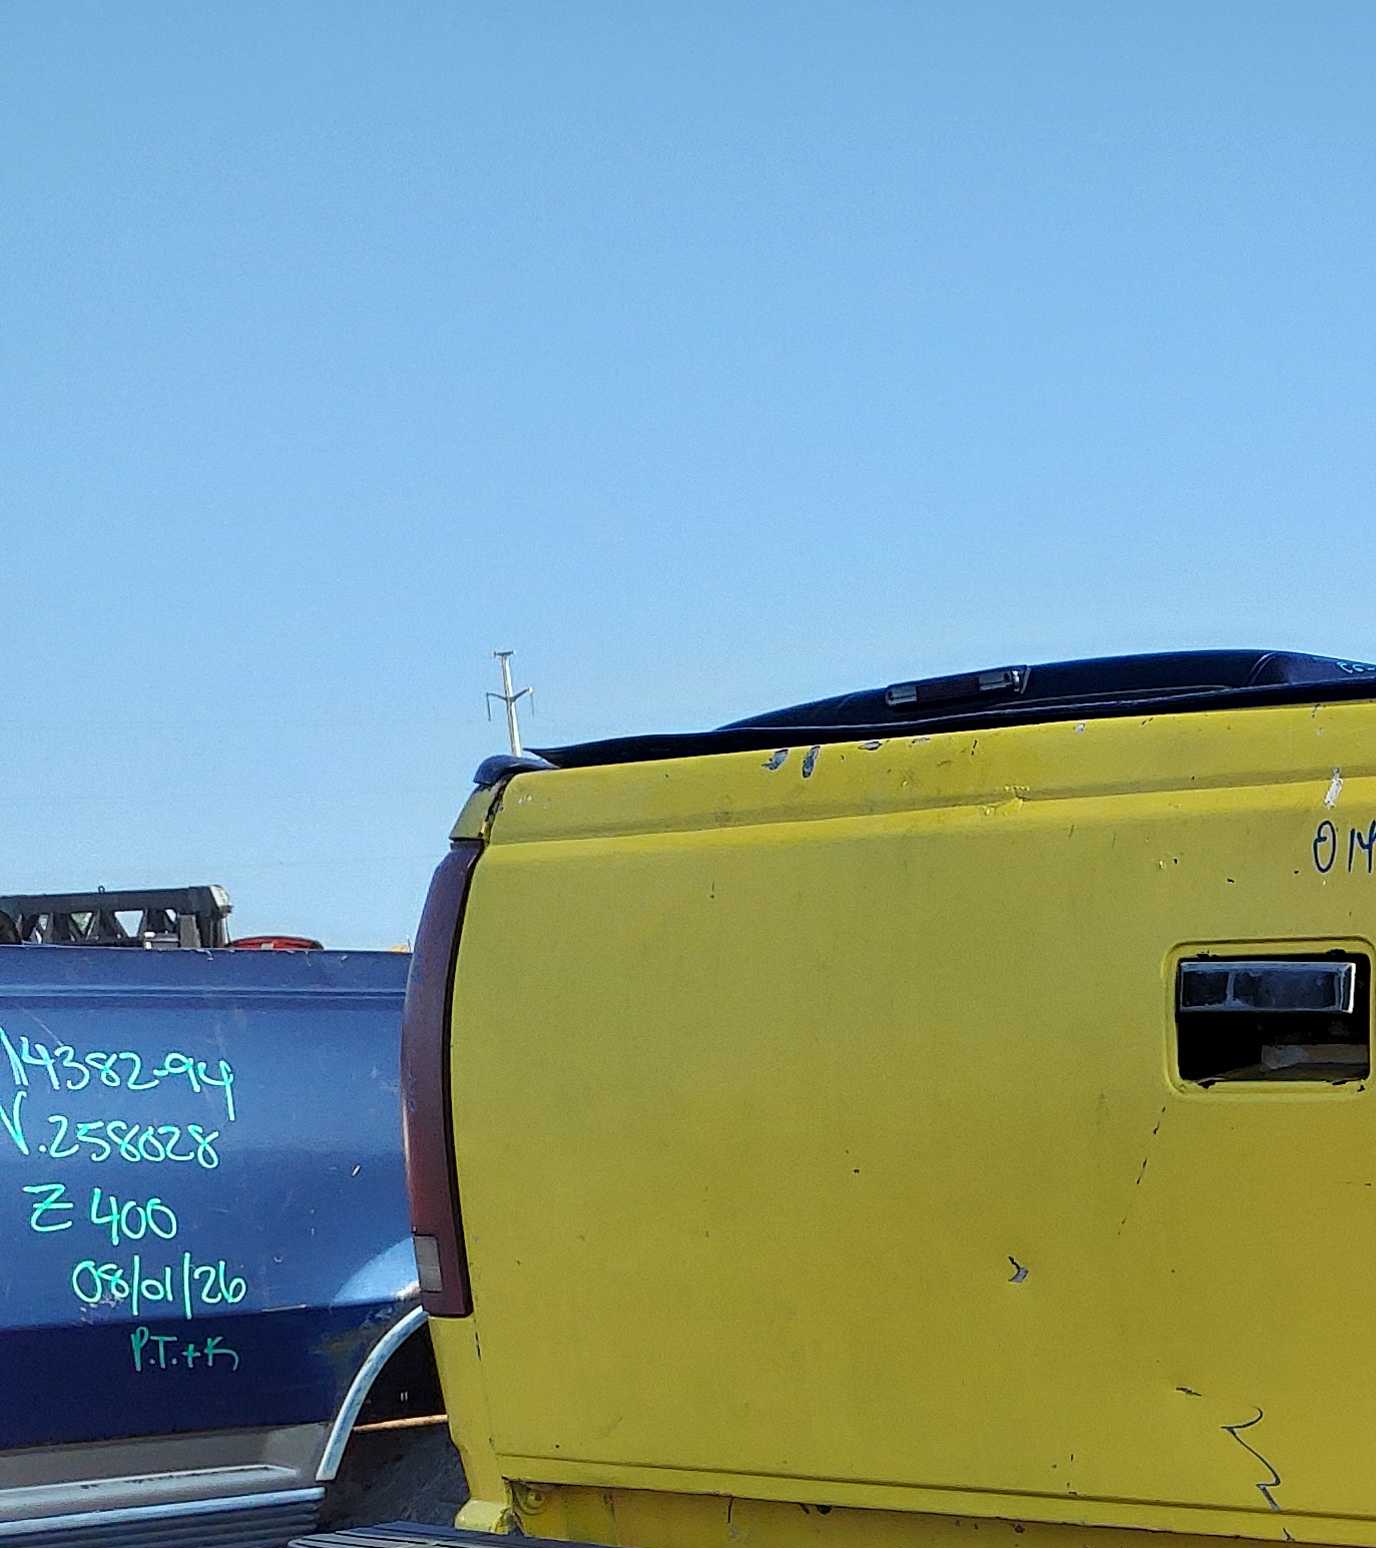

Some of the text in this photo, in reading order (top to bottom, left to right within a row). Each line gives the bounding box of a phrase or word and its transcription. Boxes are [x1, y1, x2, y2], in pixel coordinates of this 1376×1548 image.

[23, 1183, 178, 1245] Z 400
[72, 1252, 247, 1320] 08/01/26
